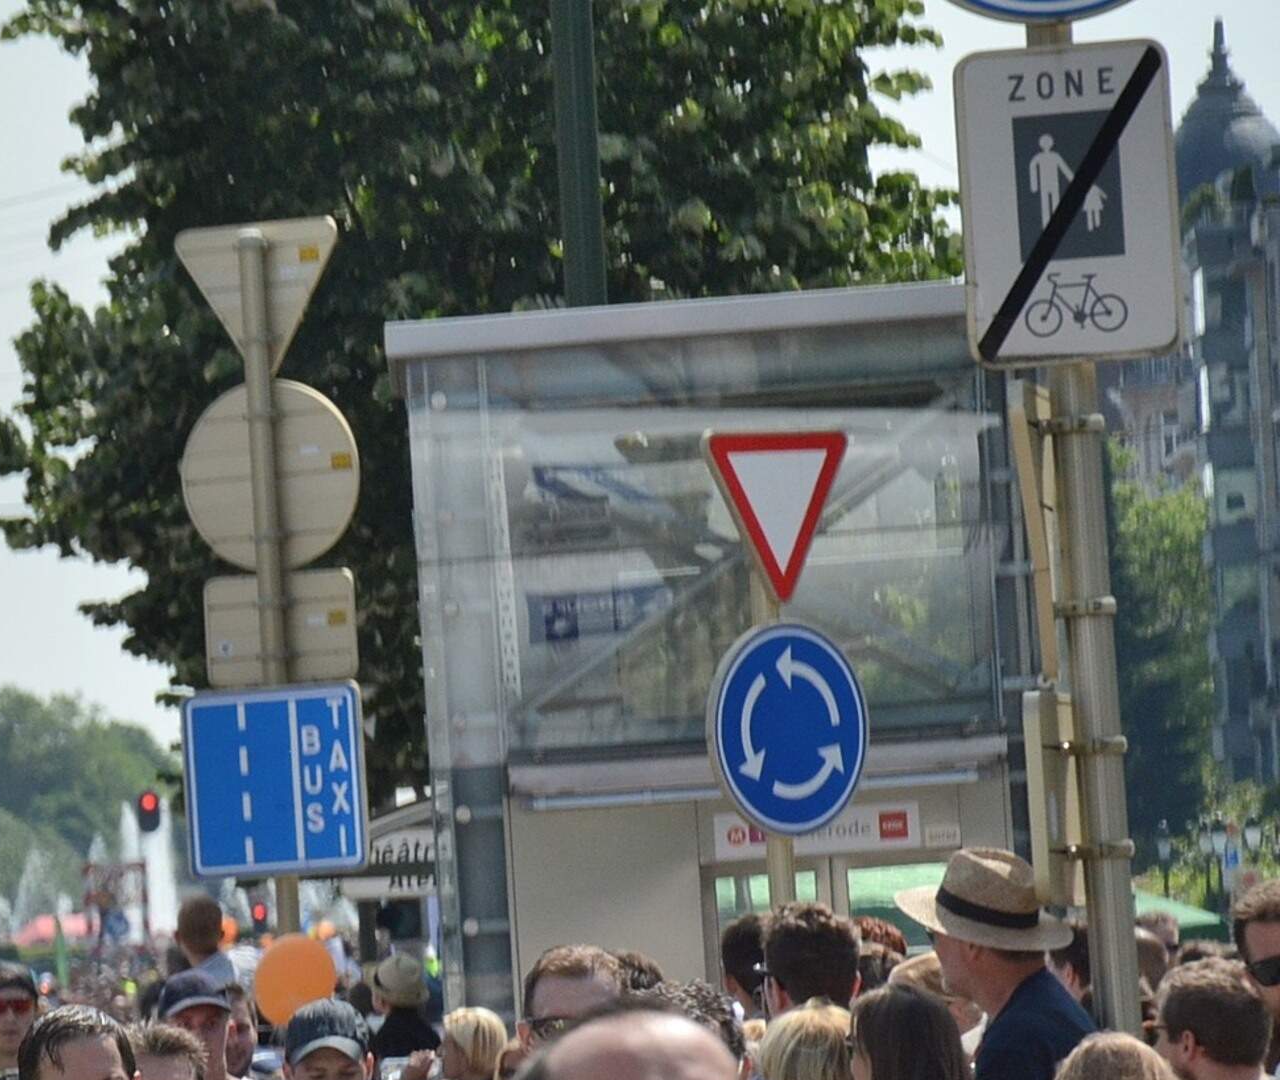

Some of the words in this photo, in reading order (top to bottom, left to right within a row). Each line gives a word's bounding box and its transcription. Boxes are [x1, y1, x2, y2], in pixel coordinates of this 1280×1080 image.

[1008, 67, 1115, 102] ZONE
[300, 724, 326, 833] BUS
[326, 697, 351, 857] TAXI
